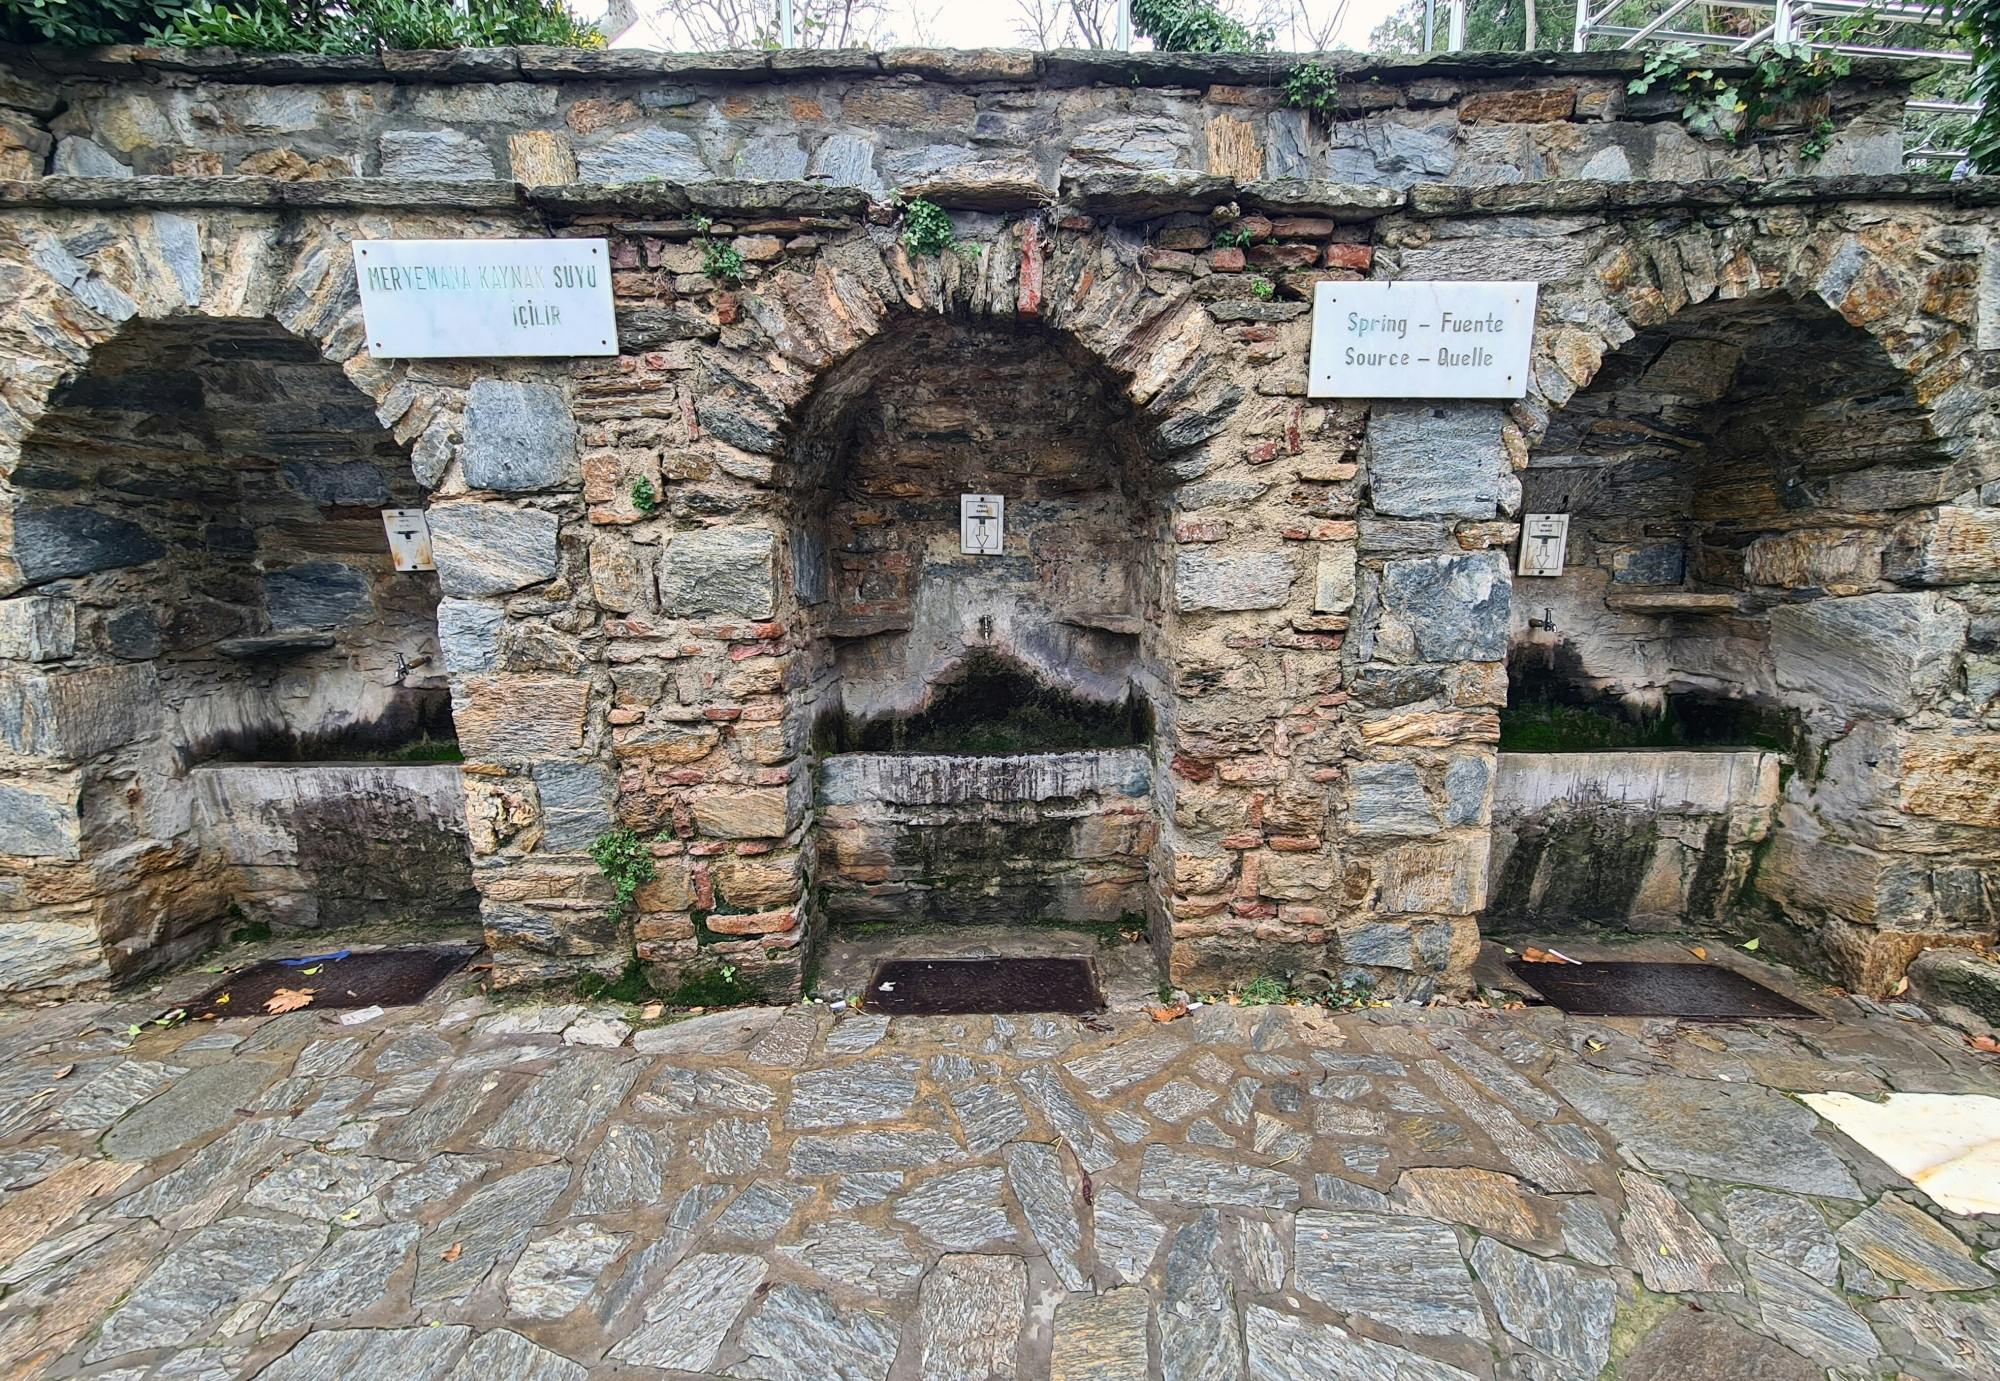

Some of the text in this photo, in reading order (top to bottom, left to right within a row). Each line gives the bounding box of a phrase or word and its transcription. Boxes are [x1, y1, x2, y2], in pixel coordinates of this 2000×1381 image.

[367, 266, 472, 291] MERYEMANA
[478, 265, 545, 289] KAYNAK
[1347, 311, 1408, 339] Spring
[1440, 311, 1504, 333] Fuente
[1345, 346, 1410, 366] Source
[1437, 346, 1494, 367] Quelle
